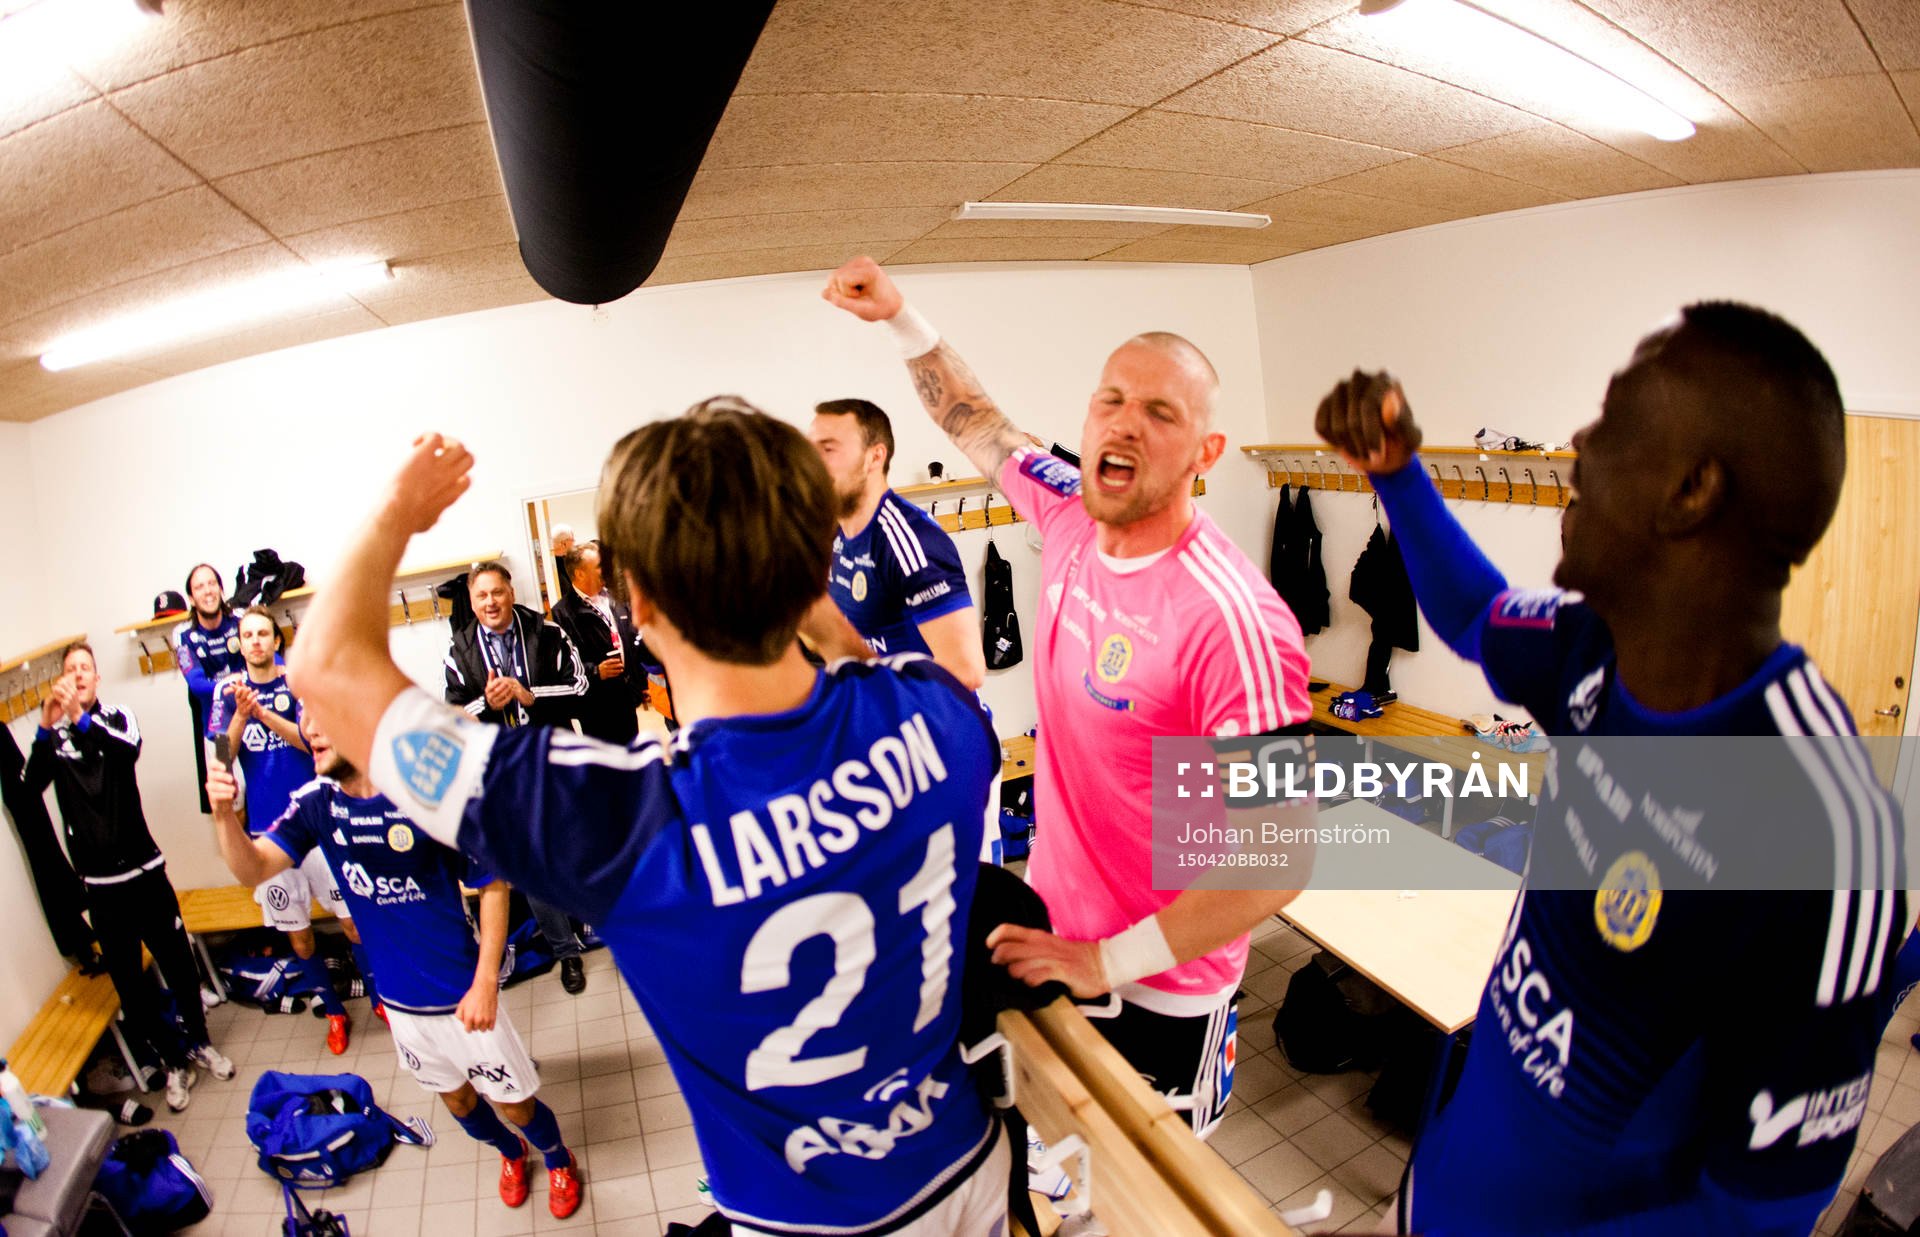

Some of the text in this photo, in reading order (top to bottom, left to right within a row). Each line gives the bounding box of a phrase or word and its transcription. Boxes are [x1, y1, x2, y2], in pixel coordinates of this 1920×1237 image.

[691, 712, 948, 907] LARSSON
[375, 876, 421, 895] SCA
[376, 891, 427, 906] Care of Life
[740, 822, 957, 1092] 21
[1502, 938, 1573, 1067] SCA
[1523, 1047, 1566, 1098] Life
